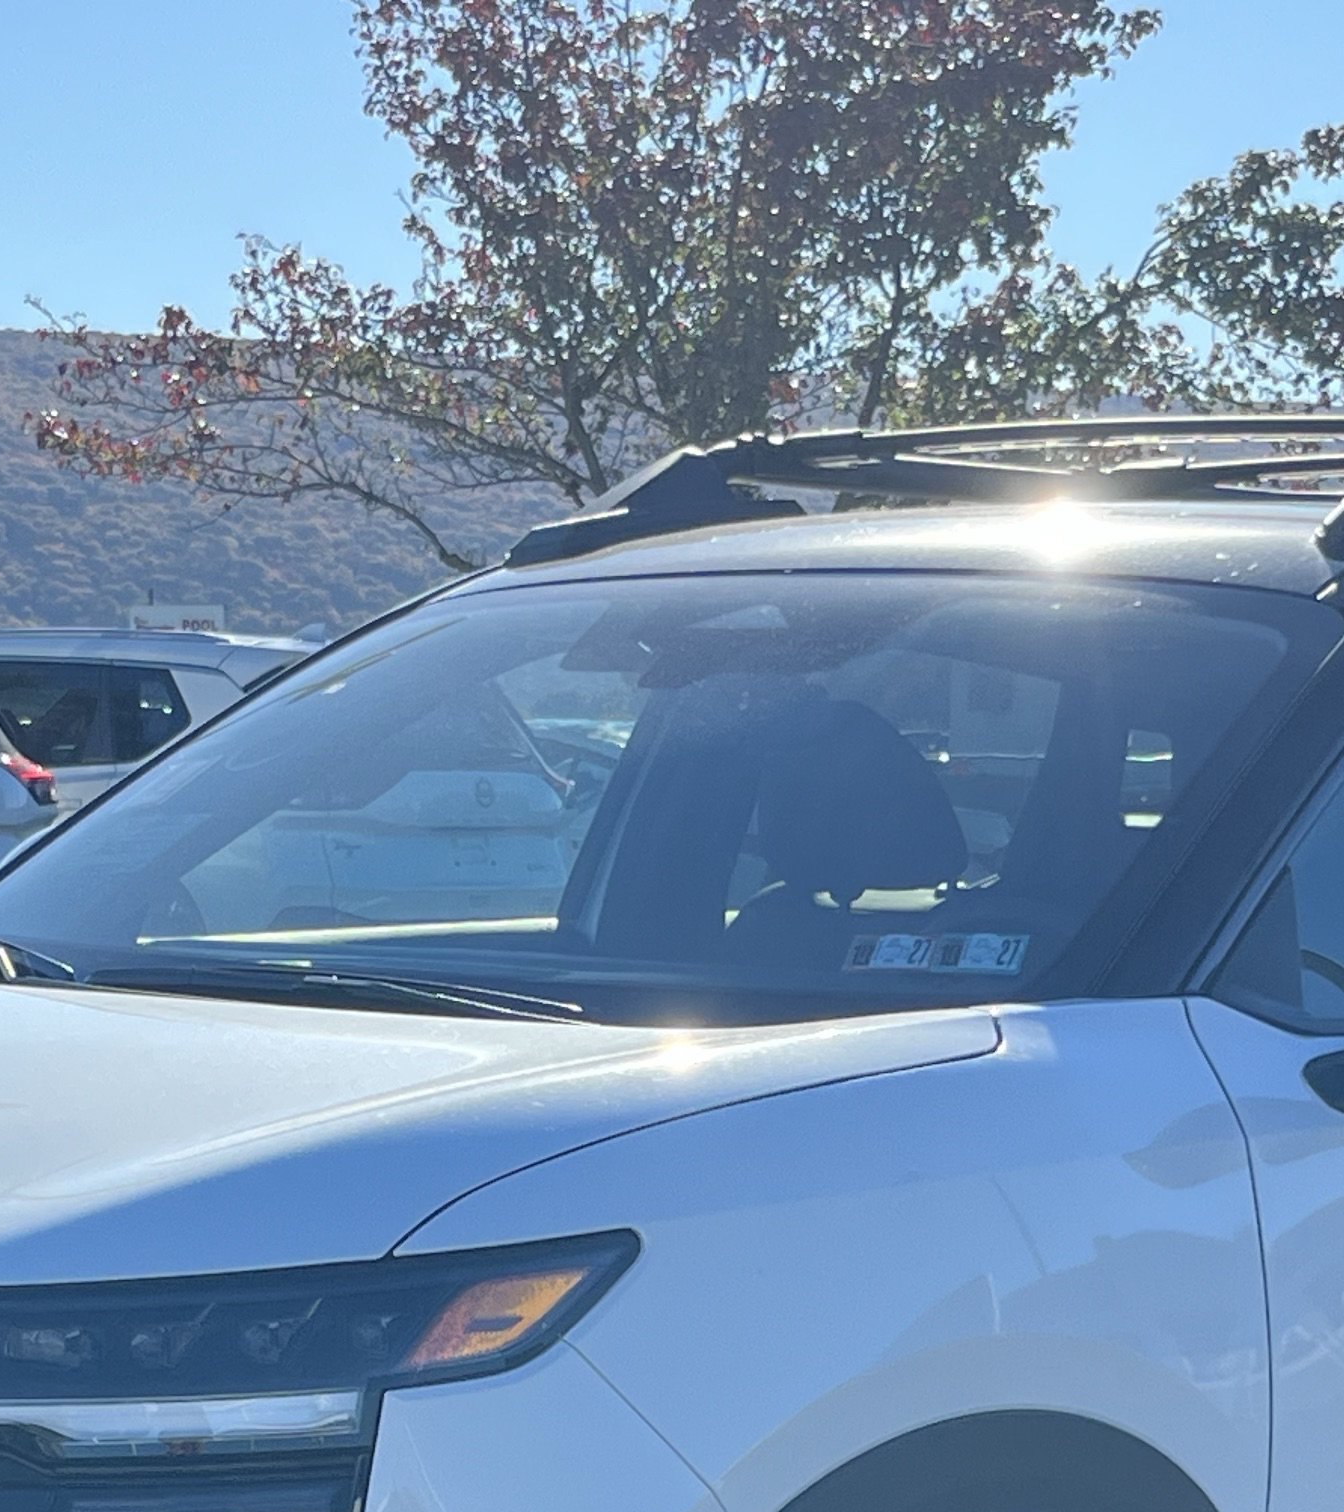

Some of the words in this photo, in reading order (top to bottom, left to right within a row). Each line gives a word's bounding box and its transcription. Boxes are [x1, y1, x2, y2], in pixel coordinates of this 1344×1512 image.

[182, 619, 218, 632] POOL
[906, 939, 932, 966] 27
[996, 939, 1022, 966] 27
